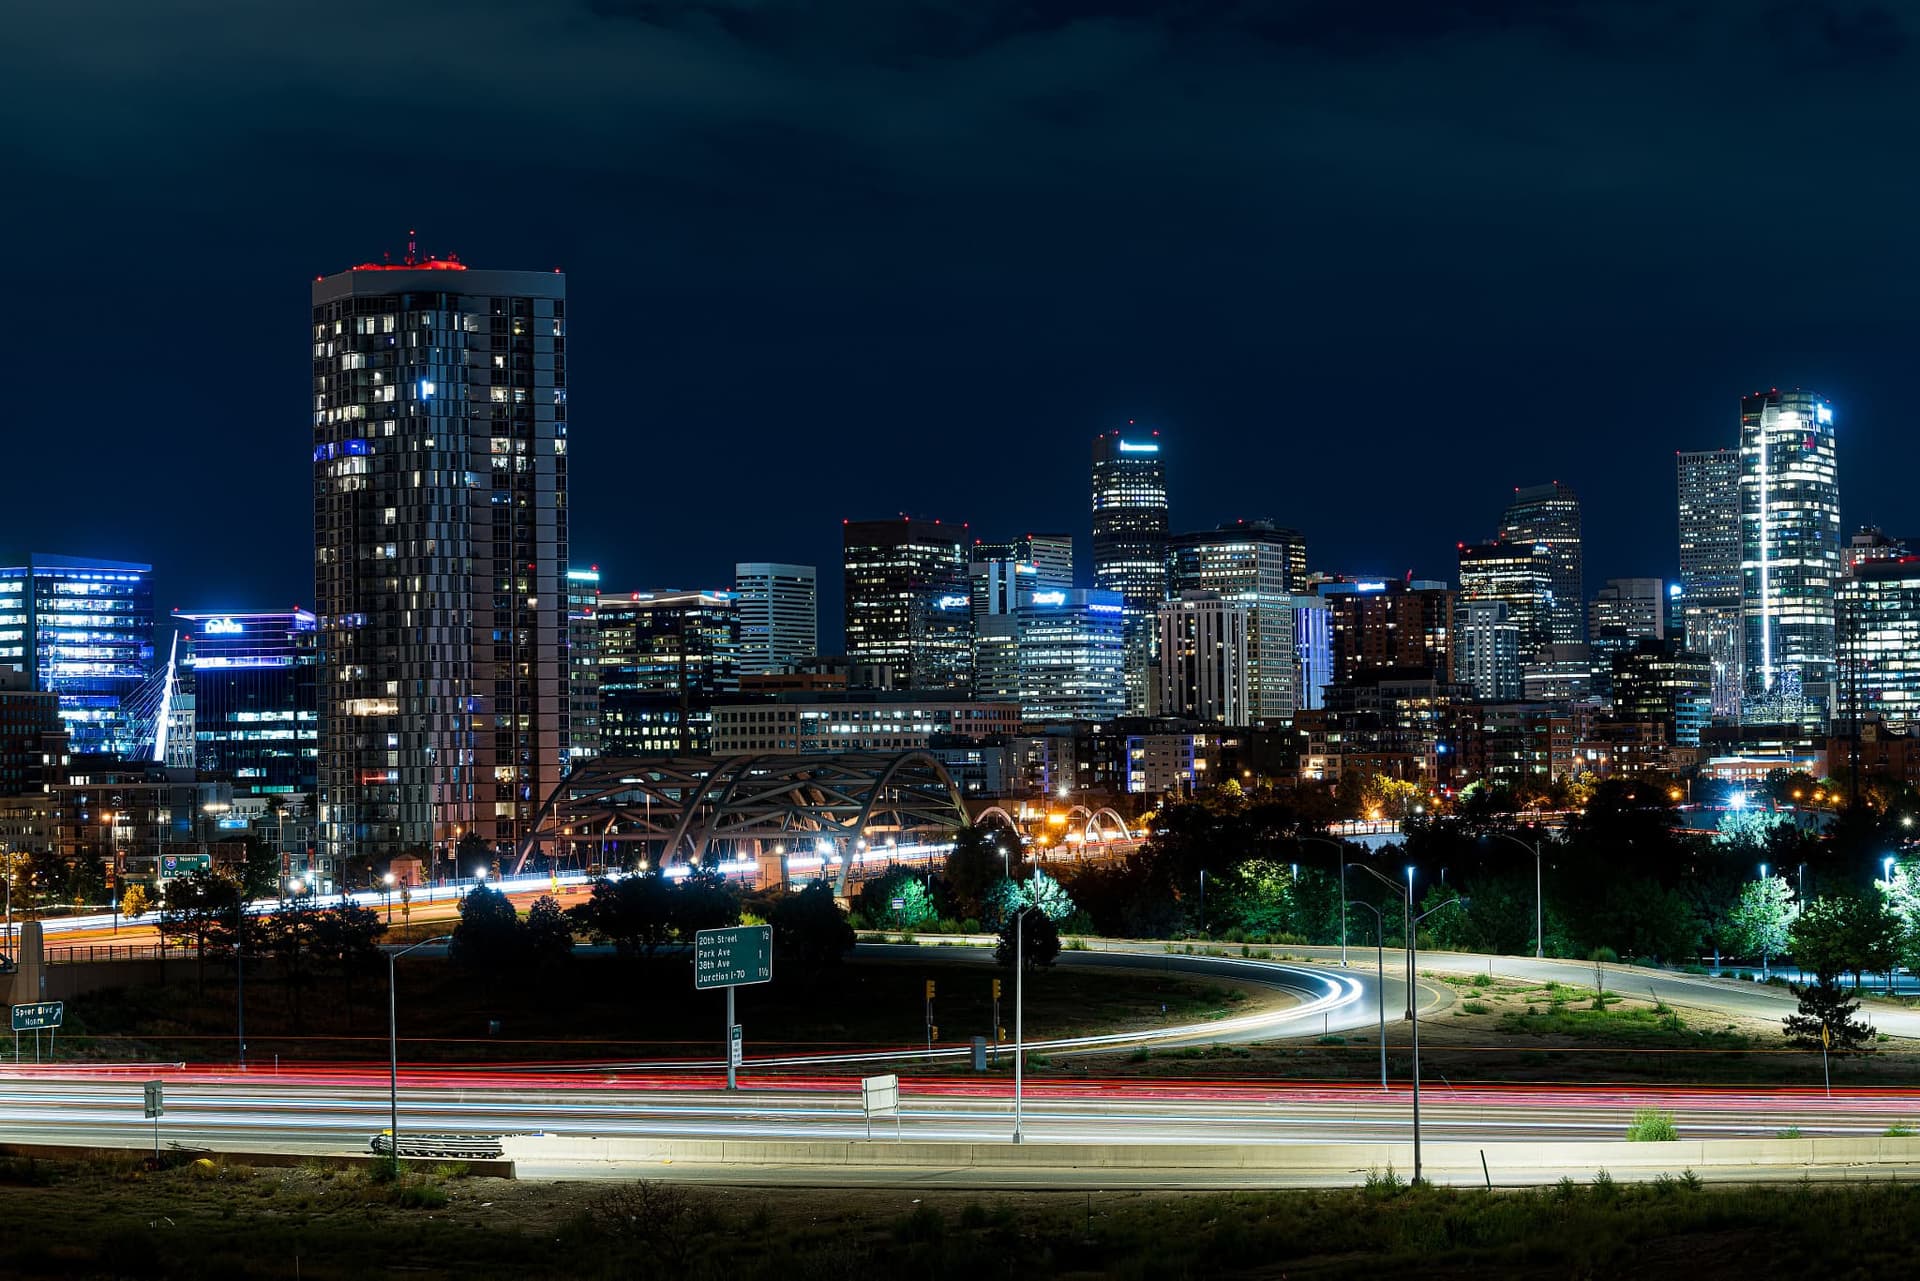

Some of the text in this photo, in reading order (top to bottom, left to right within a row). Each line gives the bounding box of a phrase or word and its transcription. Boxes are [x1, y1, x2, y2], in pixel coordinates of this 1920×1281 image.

[699, 936, 715, 945] 20th
[717, 934, 737, 943] Street
[699, 950, 715, 958] Park
[718, 949, 730, 957] Ave
[699, 960, 730, 970] 38th Ave
[699, 972, 728, 983] Junction
[731, 970, 745, 979] I-70
